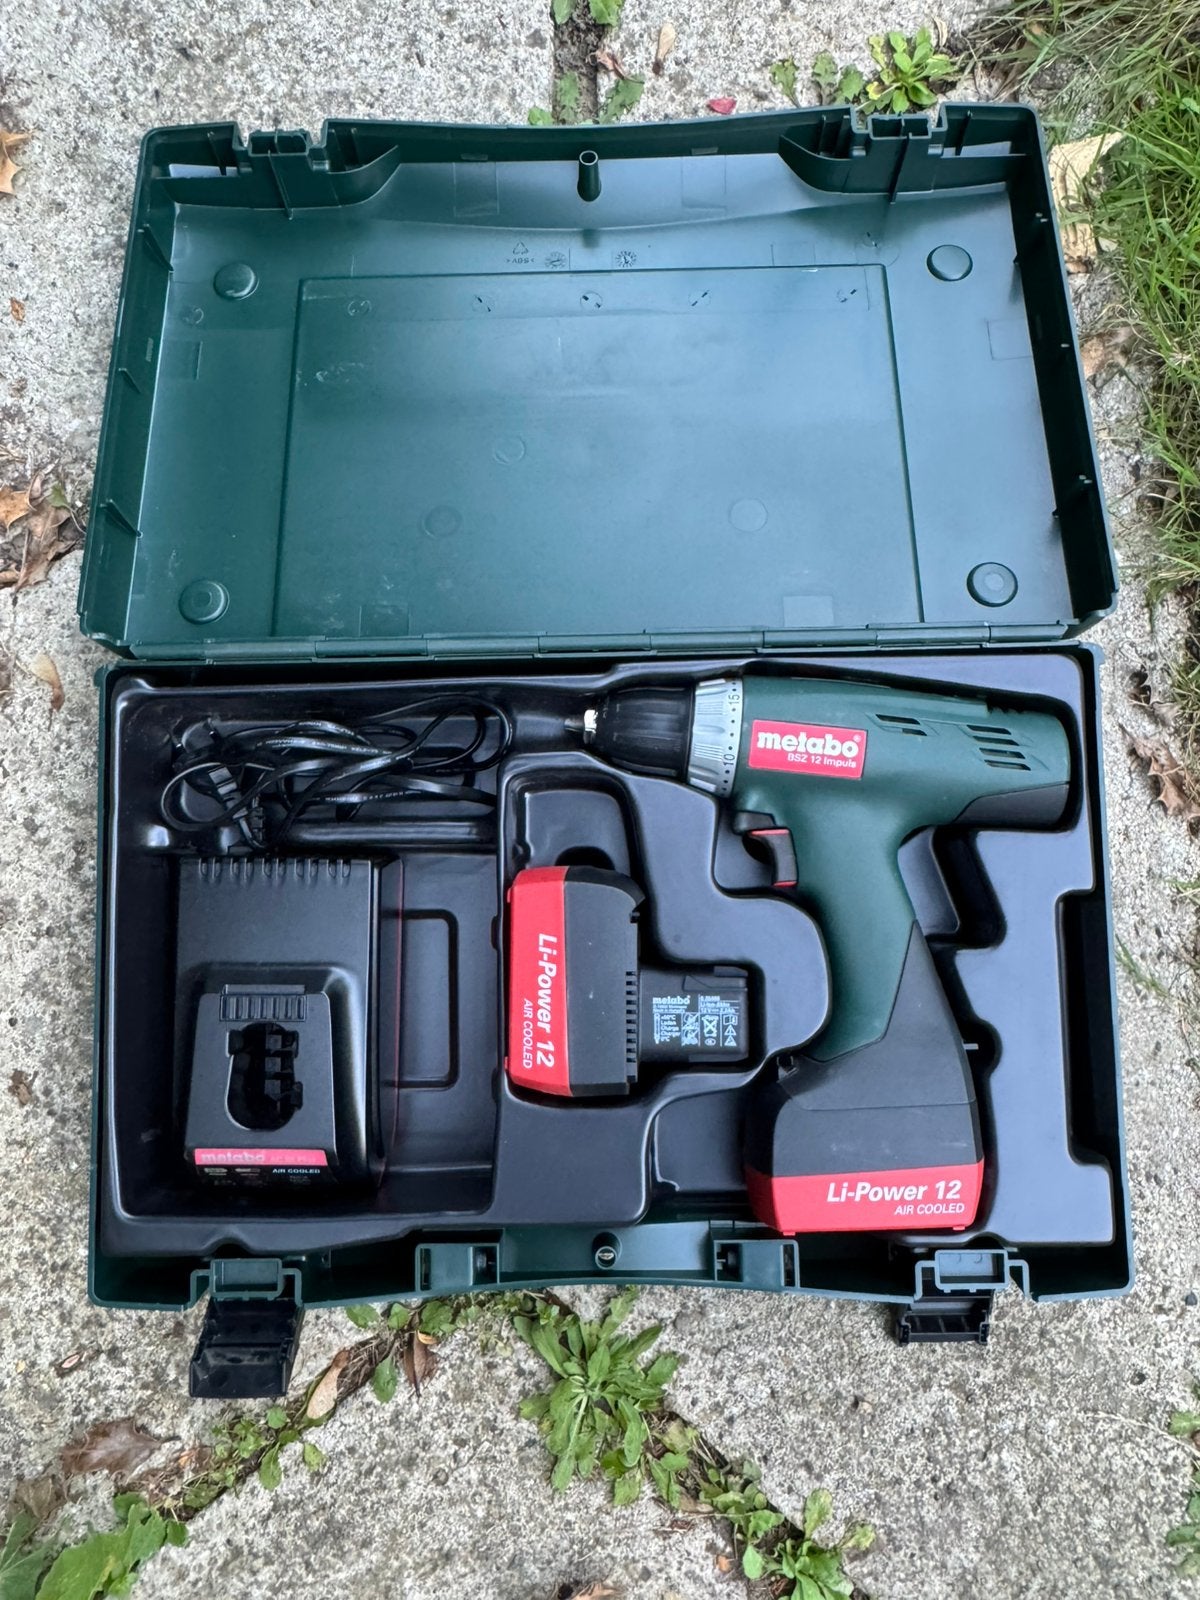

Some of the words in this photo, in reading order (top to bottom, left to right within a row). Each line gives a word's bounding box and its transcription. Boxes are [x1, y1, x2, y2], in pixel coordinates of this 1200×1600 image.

[728, 694, 740, 705] 15
[757, 731, 860, 758] metabo
[724, 753, 735, 766] 10
[787, 752, 807, 763] BSZ
[811, 755, 822, 765] 12
[823, 757, 857, 769] Impuls
[537, 933, 557, 1033] Li-Power
[523, 998, 533, 1019] AIR
[522, 1021, 533, 1069] COOLED
[536, 1040, 555, 1068] 12
[826, 1181, 929, 1203] Li-Power
[935, 1179, 963, 1200] 12
[893, 1205, 915, 1216] AIR
[916, 1203, 966, 1214] COOLED
